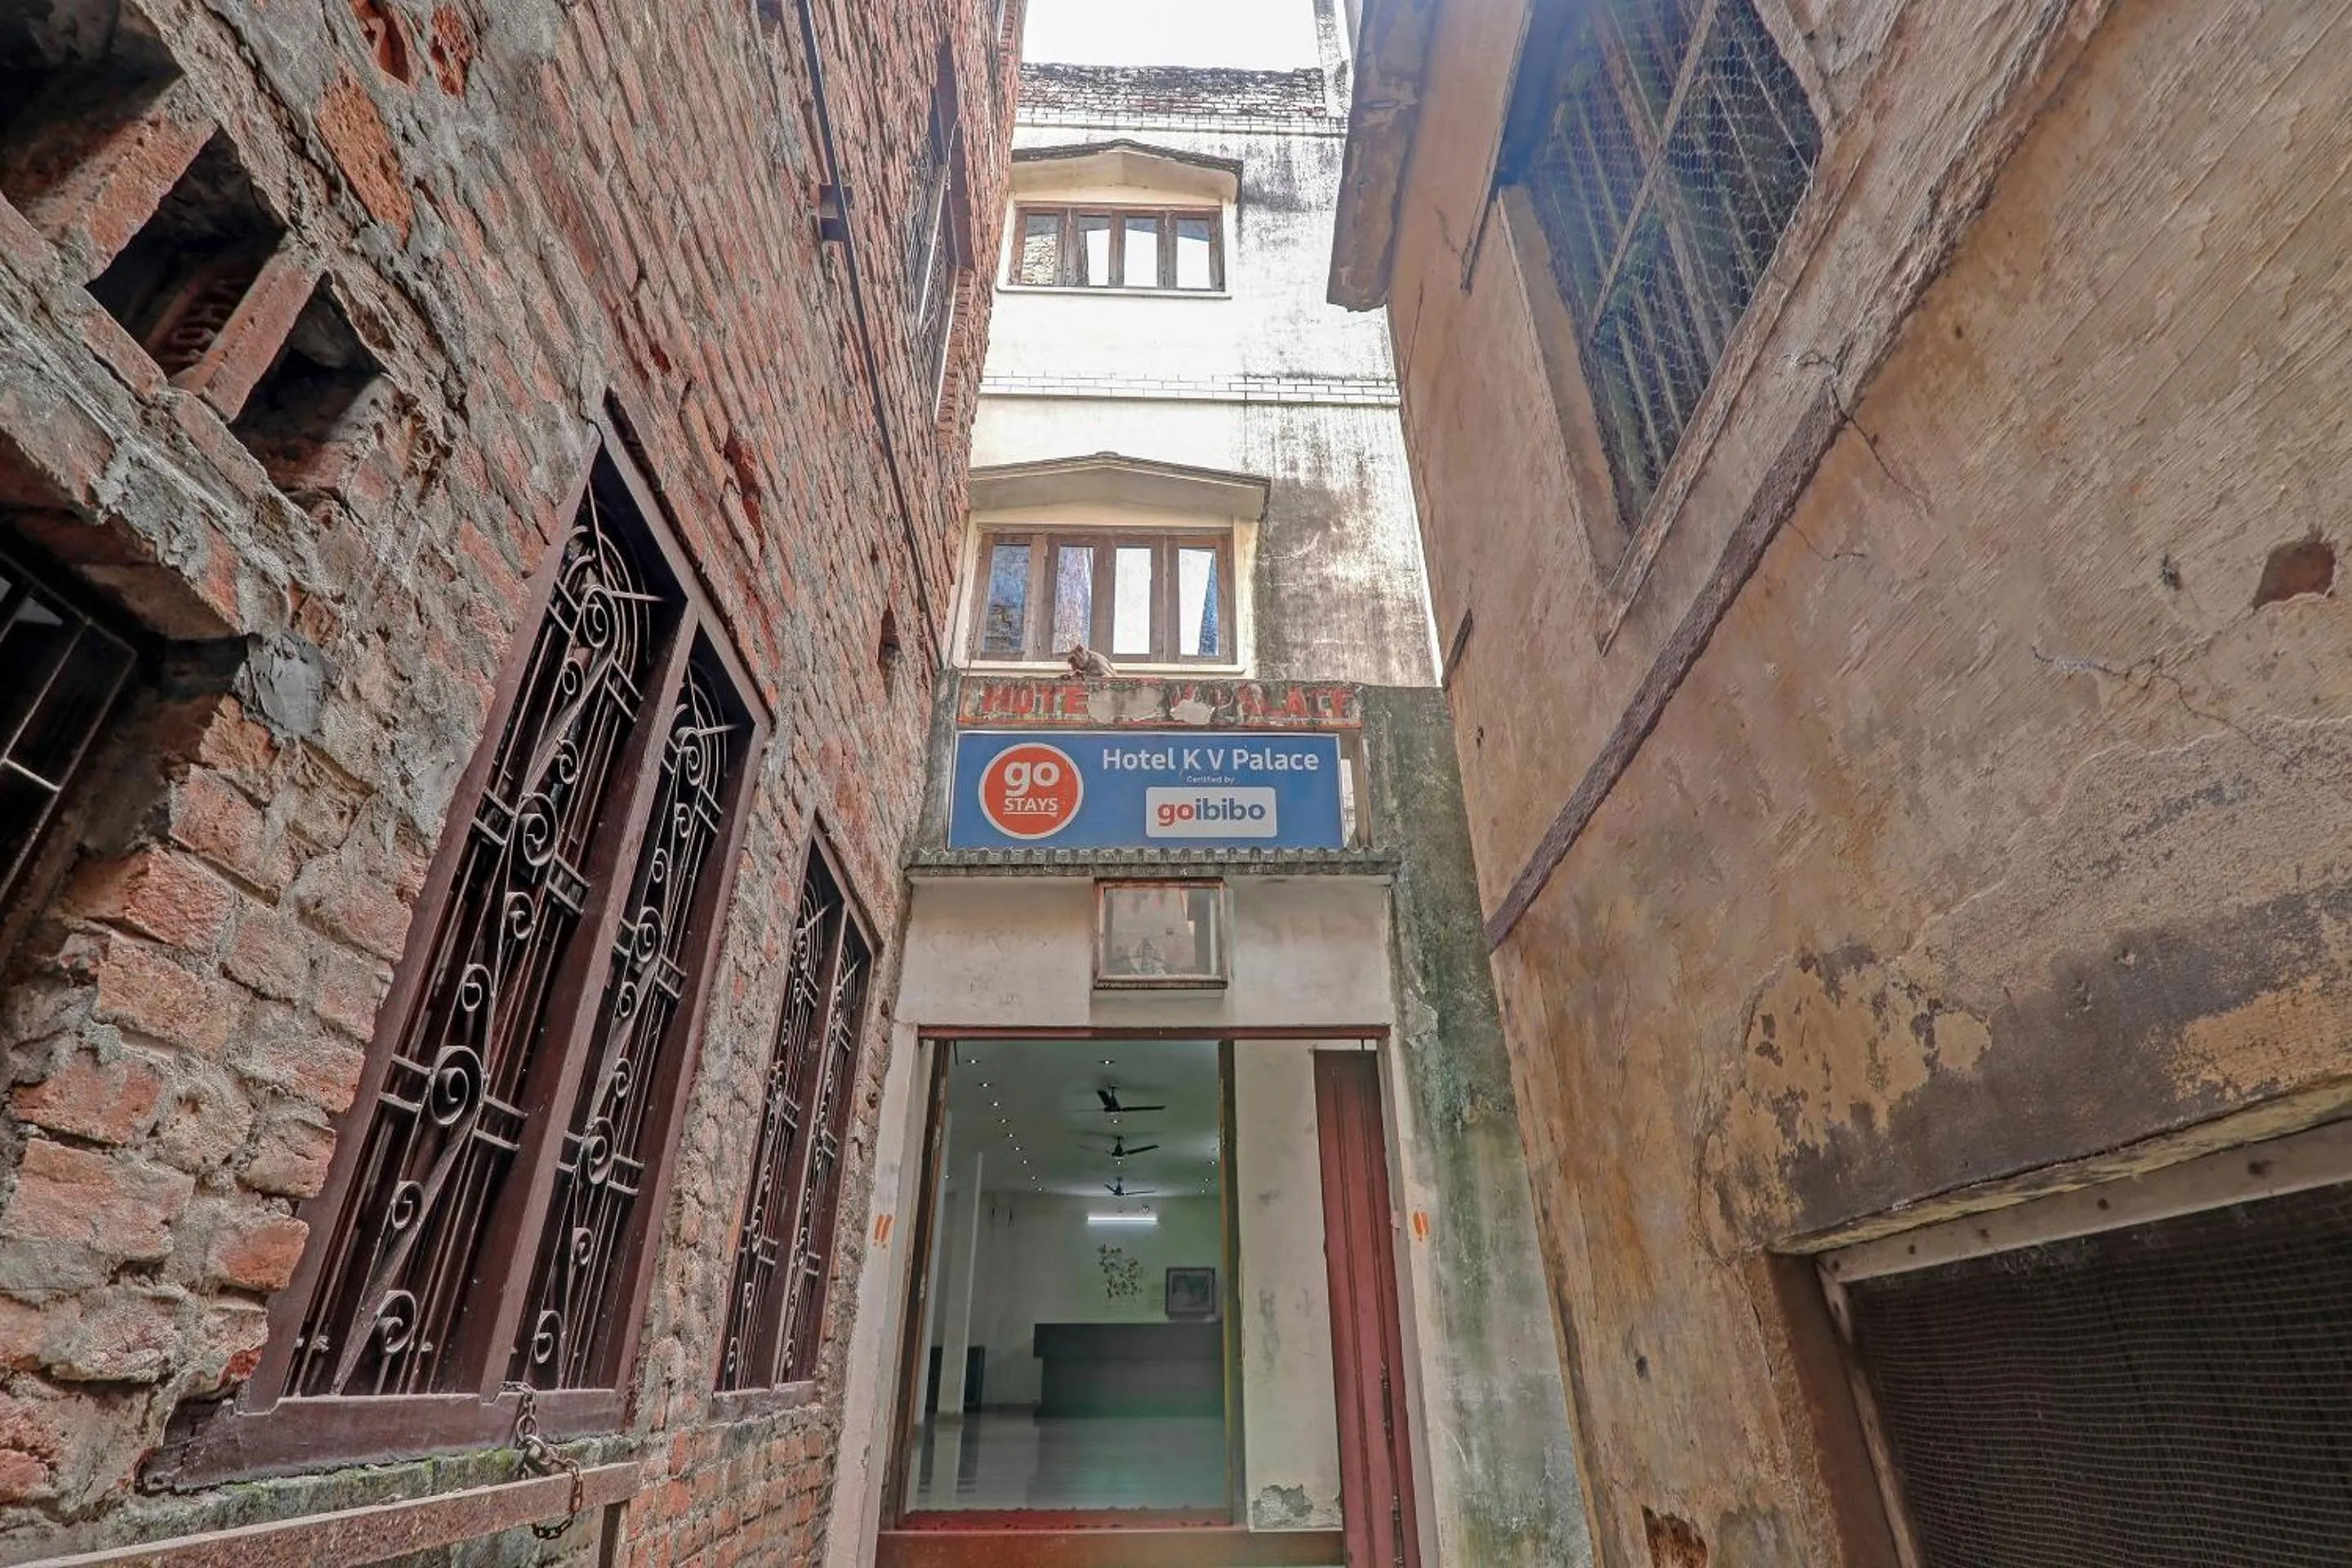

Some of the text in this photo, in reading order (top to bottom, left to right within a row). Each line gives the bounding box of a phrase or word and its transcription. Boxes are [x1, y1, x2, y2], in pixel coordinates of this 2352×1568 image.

[981, 683, 1089, 715] HOTE
[1102, 746, 1320, 771] Hotel K V Palace
[1004, 761, 1061, 797] go
[1223, 775, 1236, 785] by
[1004, 797, 1058, 812] STAYS
[1157, 797, 1267, 827] goibibo
